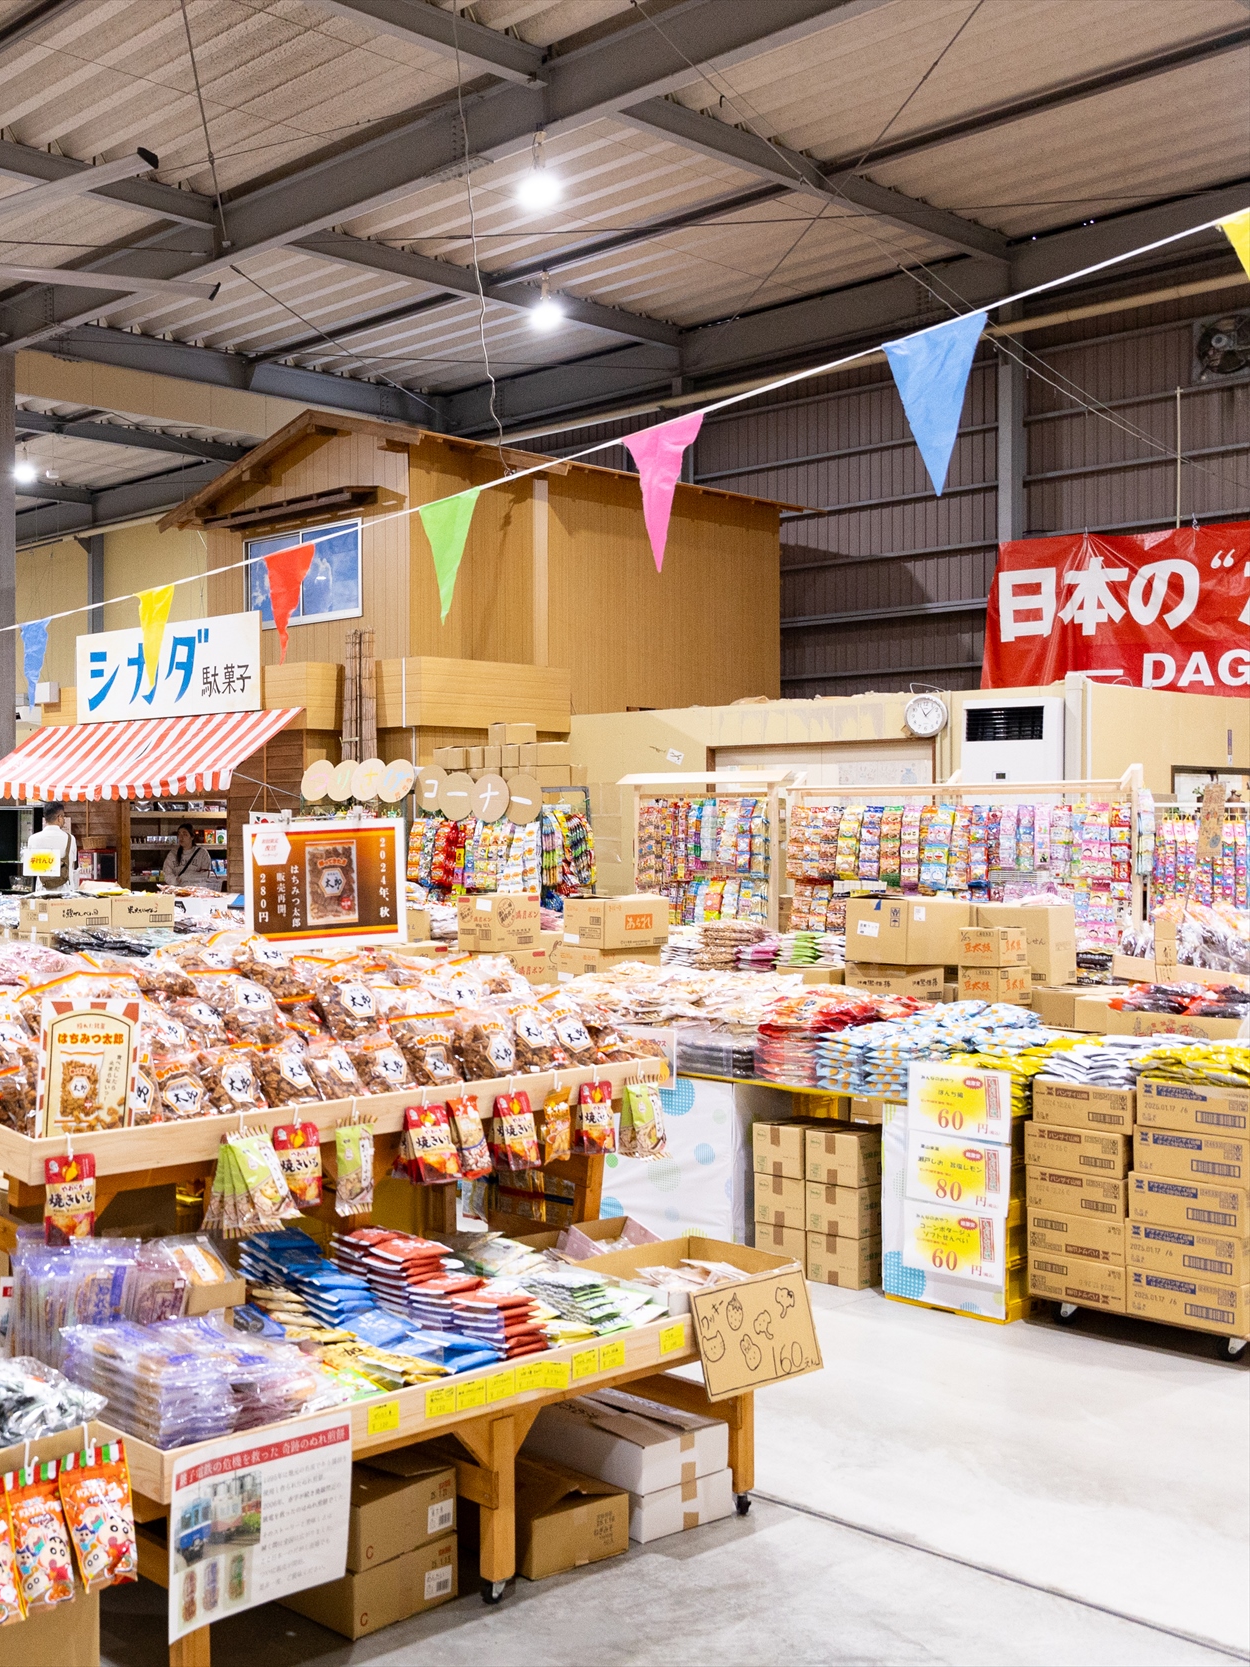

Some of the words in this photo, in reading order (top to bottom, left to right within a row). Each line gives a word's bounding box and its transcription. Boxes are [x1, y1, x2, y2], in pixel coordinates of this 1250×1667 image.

[201, 663, 252, 698] 駄菓子
[424, 779, 532, 812] コーナー
[379, 837, 390, 918] 2024年、秋
[259, 873, 269, 923] 280円
[290, 864, 301, 928] はちみつ太郎
[57, 1032, 124, 1045] はちみつ太郎
[937, 1108, 964, 1131] 60
[49, 1190, 93, 1208] 焼きいも
[935, 1178, 962, 1202] 80
[931, 1248, 958, 1271] 60
[771, 1341, 803, 1377] 160
[281, 1429, 346, 1456] 奇跡のぬれ煎餅
[365, 1545, 374, 1560] C
[359, 1612, 369, 1627] C
